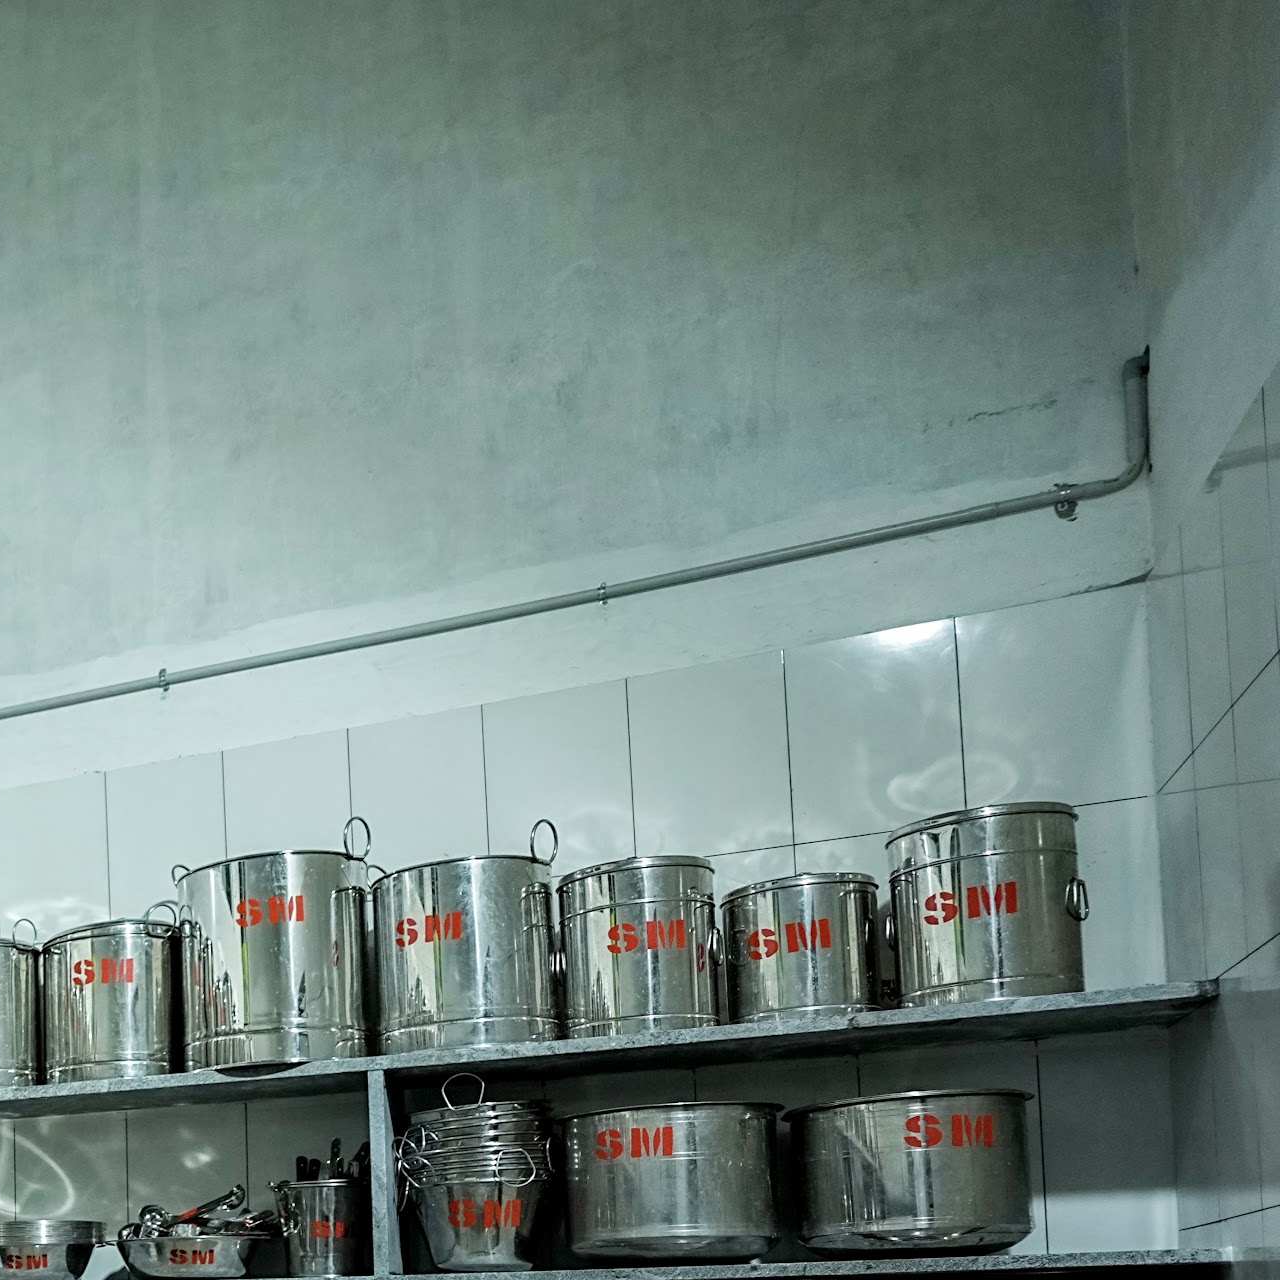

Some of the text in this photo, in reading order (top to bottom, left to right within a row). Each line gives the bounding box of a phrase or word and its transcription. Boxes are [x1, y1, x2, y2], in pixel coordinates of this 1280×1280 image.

[235, 895, 305, 928] SM
[924, 881, 1018, 926] SM
[396, 911, 463, 948] SM
[607, 919, 686, 955] SM
[748, 918, 832, 961] SM
[73, 957, 134, 986] SM
[596, 1126, 674, 1160] SM
[904, 1114, 994, 1148] SM
[448, 1199, 521, 1228] SM
[6, 1254, 48, 1270] SM
[169, 1249, 215, 1265] SM
